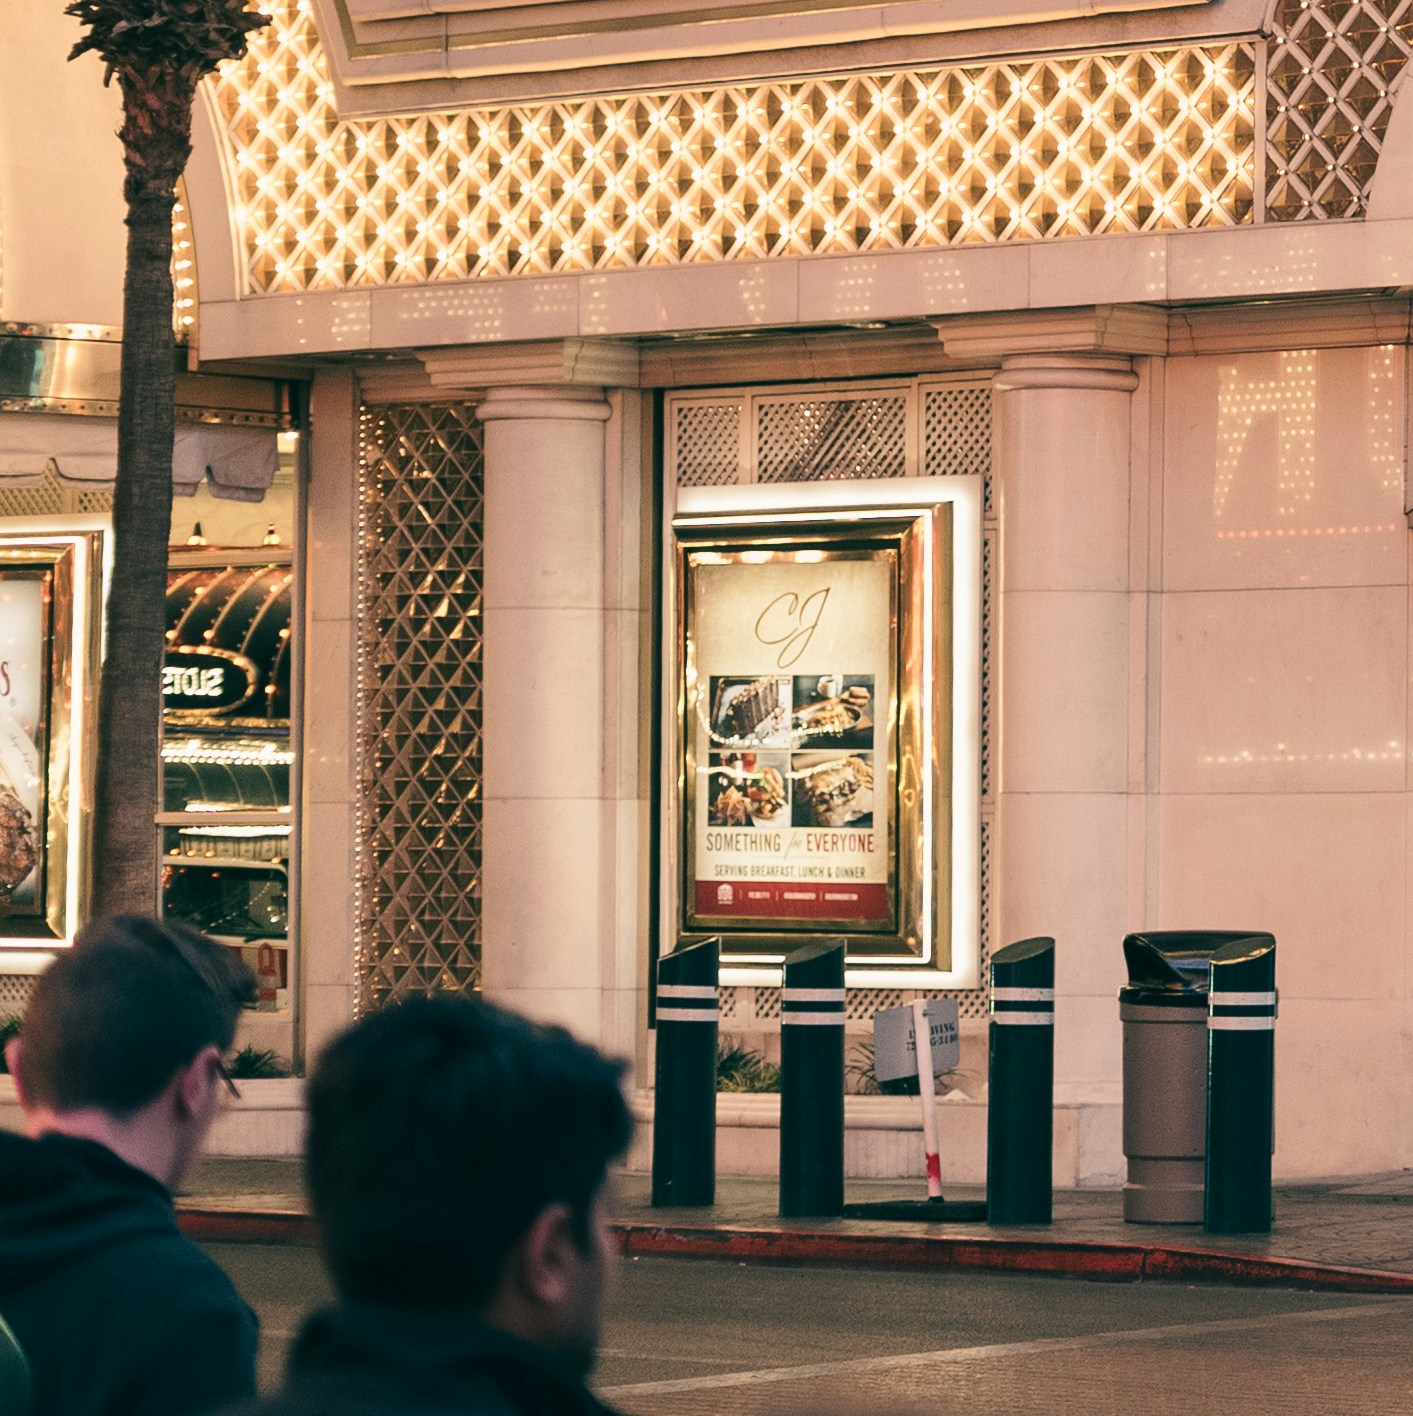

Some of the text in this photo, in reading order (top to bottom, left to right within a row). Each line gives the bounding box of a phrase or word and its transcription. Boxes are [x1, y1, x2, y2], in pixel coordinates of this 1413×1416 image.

[706, 833, 781, 852] SOMETHING
[806, 834, 874, 853] EVERYONE
[715, 865, 748, 877] SERVING
[799, 866, 824, 877] LUNCH
[827, 867, 832, 877] &
[835, 867, 866, 878] DINNER
